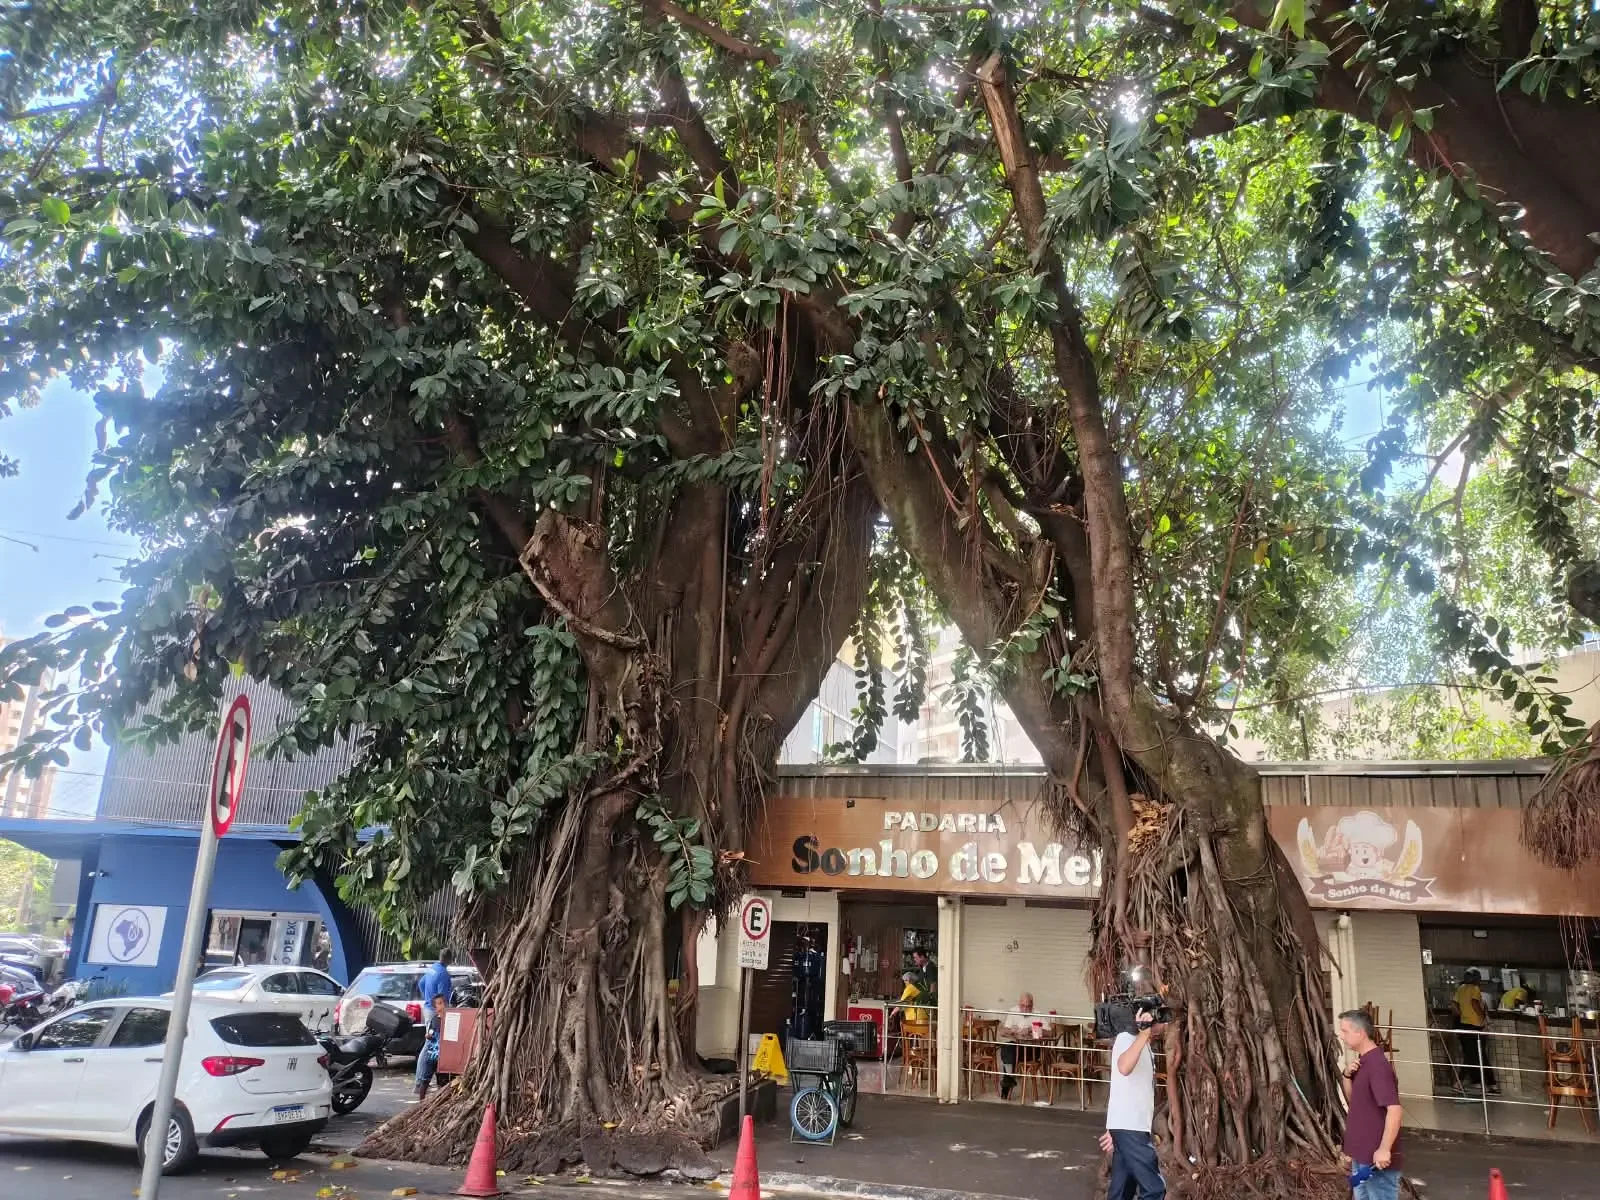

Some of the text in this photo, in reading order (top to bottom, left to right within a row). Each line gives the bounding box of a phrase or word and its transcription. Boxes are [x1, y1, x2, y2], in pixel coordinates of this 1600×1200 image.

[884, 811, 1006, 833] PADARIA
[791, 834, 1103, 887] Sonho de Mel
[1327, 883, 1411, 901] Sonho de Mel
[750, 907, 762, 931] E
